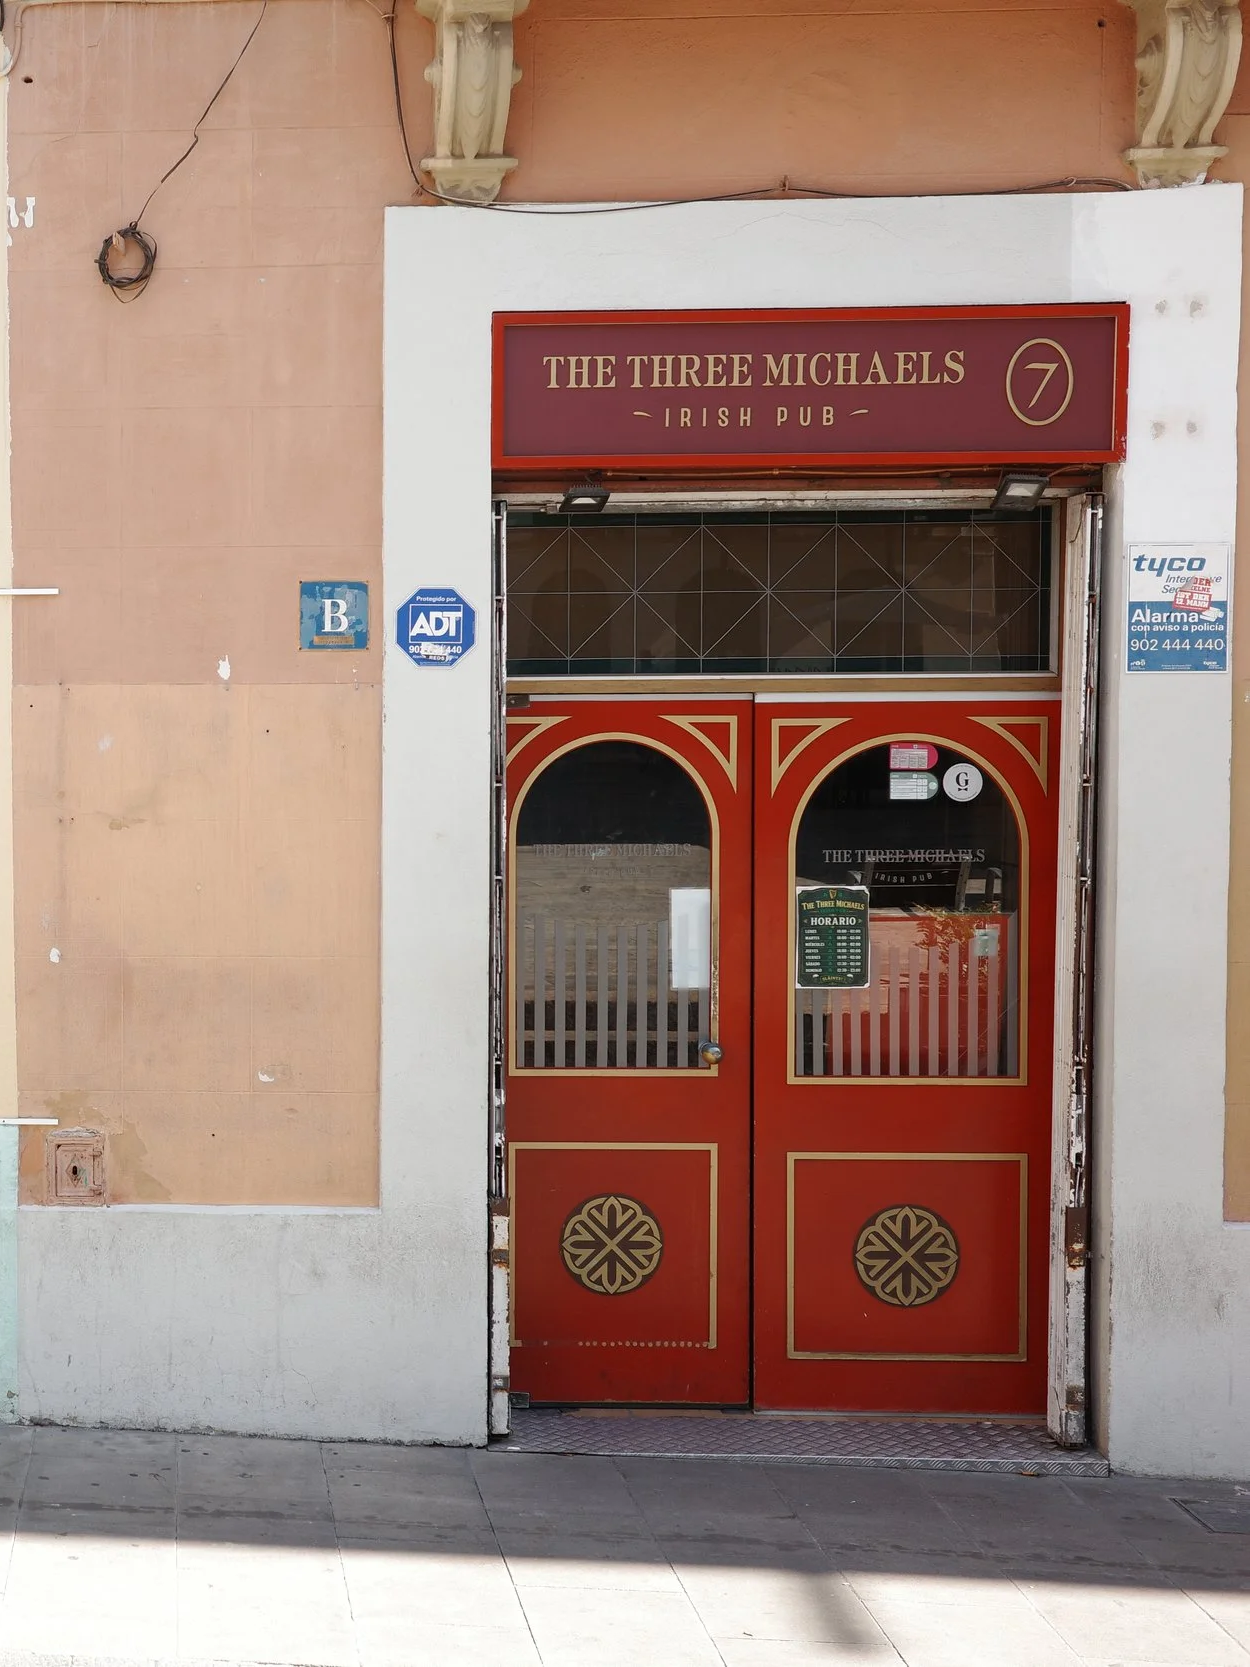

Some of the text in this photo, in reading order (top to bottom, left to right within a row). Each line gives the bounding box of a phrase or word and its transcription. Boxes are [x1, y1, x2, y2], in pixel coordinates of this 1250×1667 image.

[543, 350, 966, 388] THE THREE MICHAELS
[1023, 362, 1059, 409] 7
[665, 405, 834, 427] IRISH PUB
[1133, 554, 1206, 577] tyco
[416, 595, 445, 603] Protegido
[321, 598, 348, 632] B
[1131, 609, 1199, 623] Alarma
[410, 611, 462, 636] ADT
[1152, 623, 1180, 631] aviso
[1191, 623, 1224, 633] policía
[1130, 638, 1224, 651] 902 444 440
[955, 771, 969, 788] G
[534, 843, 691, 857] THE THREE MICHAELS
[823, 848, 986, 863] THE THREE MICHAELS
[874, 872, 933, 883] IRISH PUB
[802, 900, 865, 910] THE THREE MICHAELS
[810, 917, 856, 926] HORARIO
